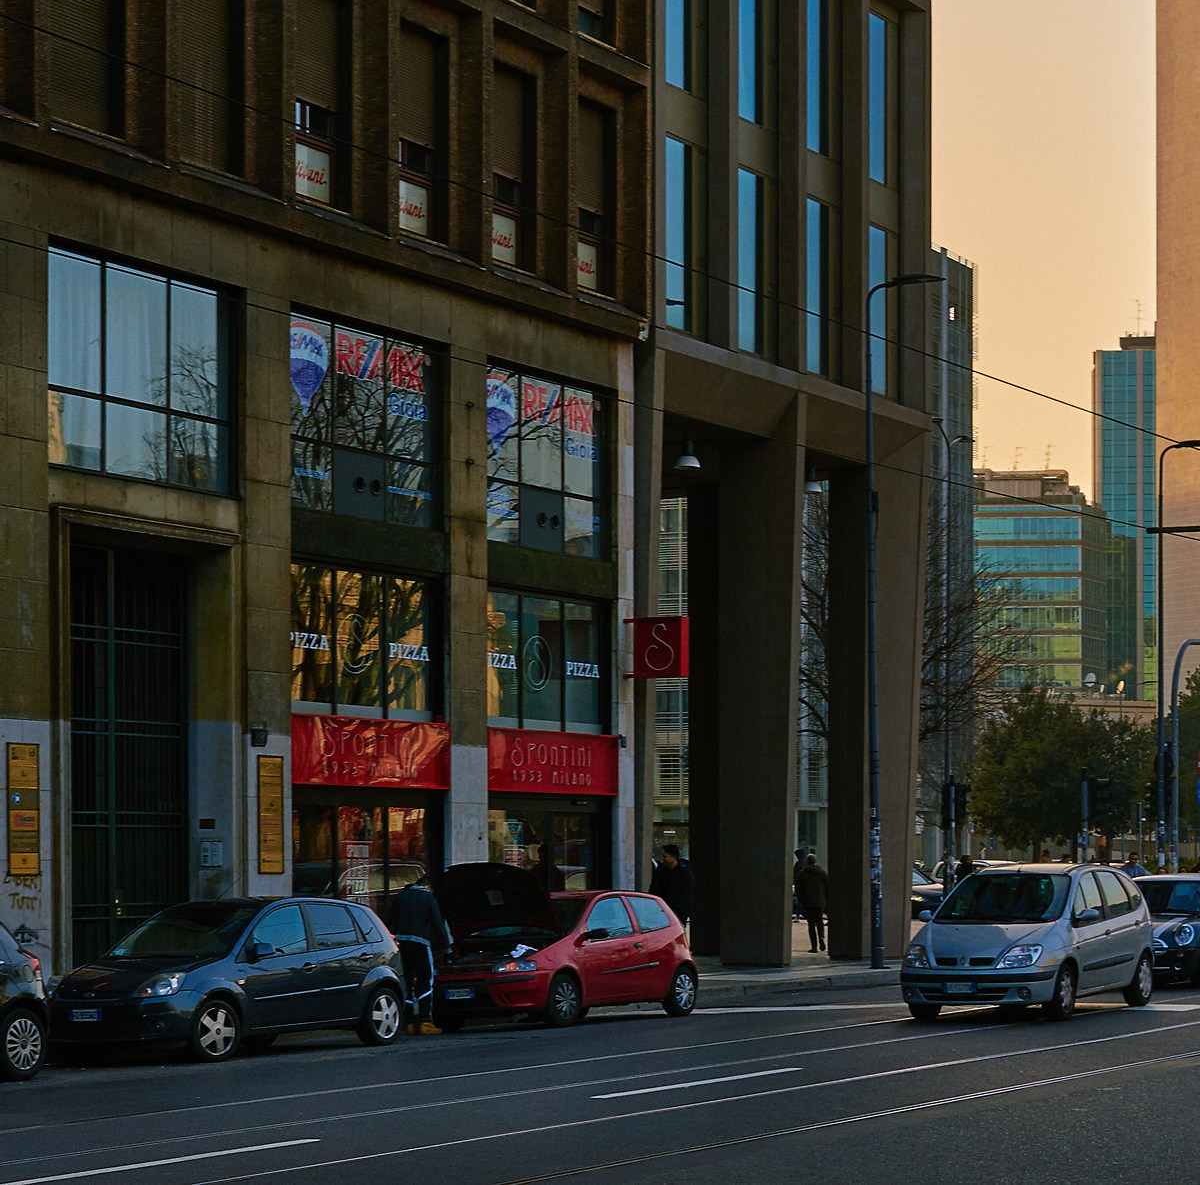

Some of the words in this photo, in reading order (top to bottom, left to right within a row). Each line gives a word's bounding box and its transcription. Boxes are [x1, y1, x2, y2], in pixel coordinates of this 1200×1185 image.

[337, 333, 427, 394] RE/MAX
[388, 393, 428, 422] Gioia
[523, 382, 597, 436] RE/MAX
[565, 437, 599, 462] Gioia
[389, 642, 431, 662] PIZZA
[487, 652, 518, 670] IZZA
[566, 661, 600, 679] PIZZA
[512, 769, 543, 783] 1953
